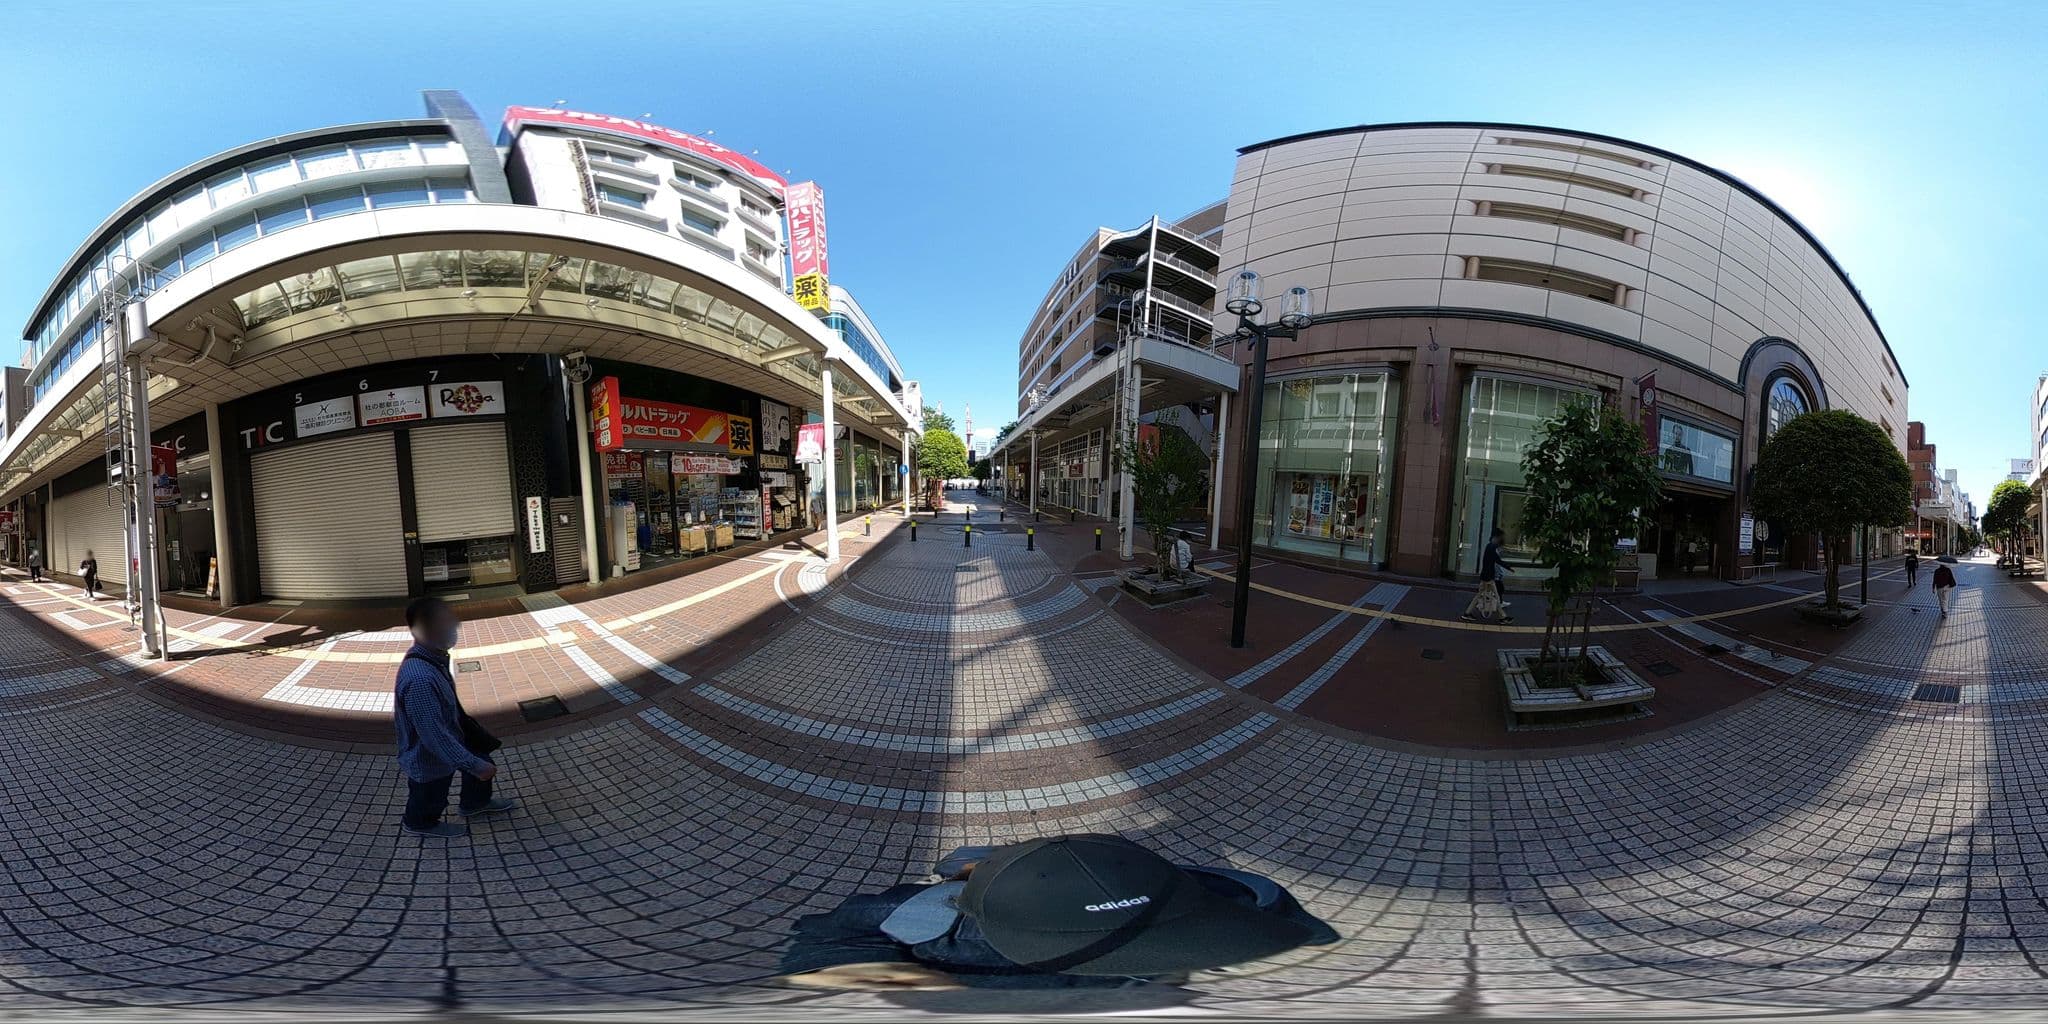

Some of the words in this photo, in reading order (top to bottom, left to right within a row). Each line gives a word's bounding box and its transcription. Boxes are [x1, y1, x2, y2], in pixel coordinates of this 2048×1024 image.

[789, 187, 815, 263] ツルハドラッグ
[795, 276, 818, 299] 薬
[359, 379, 368, 391] 6
[429, 370, 438, 382] 7
[295, 392, 303, 404] 5
[620, 404, 691, 424] ルハドラッグ
[240, 421, 284, 449] TIC
[730, 419, 750, 451] 薬
[1084, 896, 1151, 911] adidas
